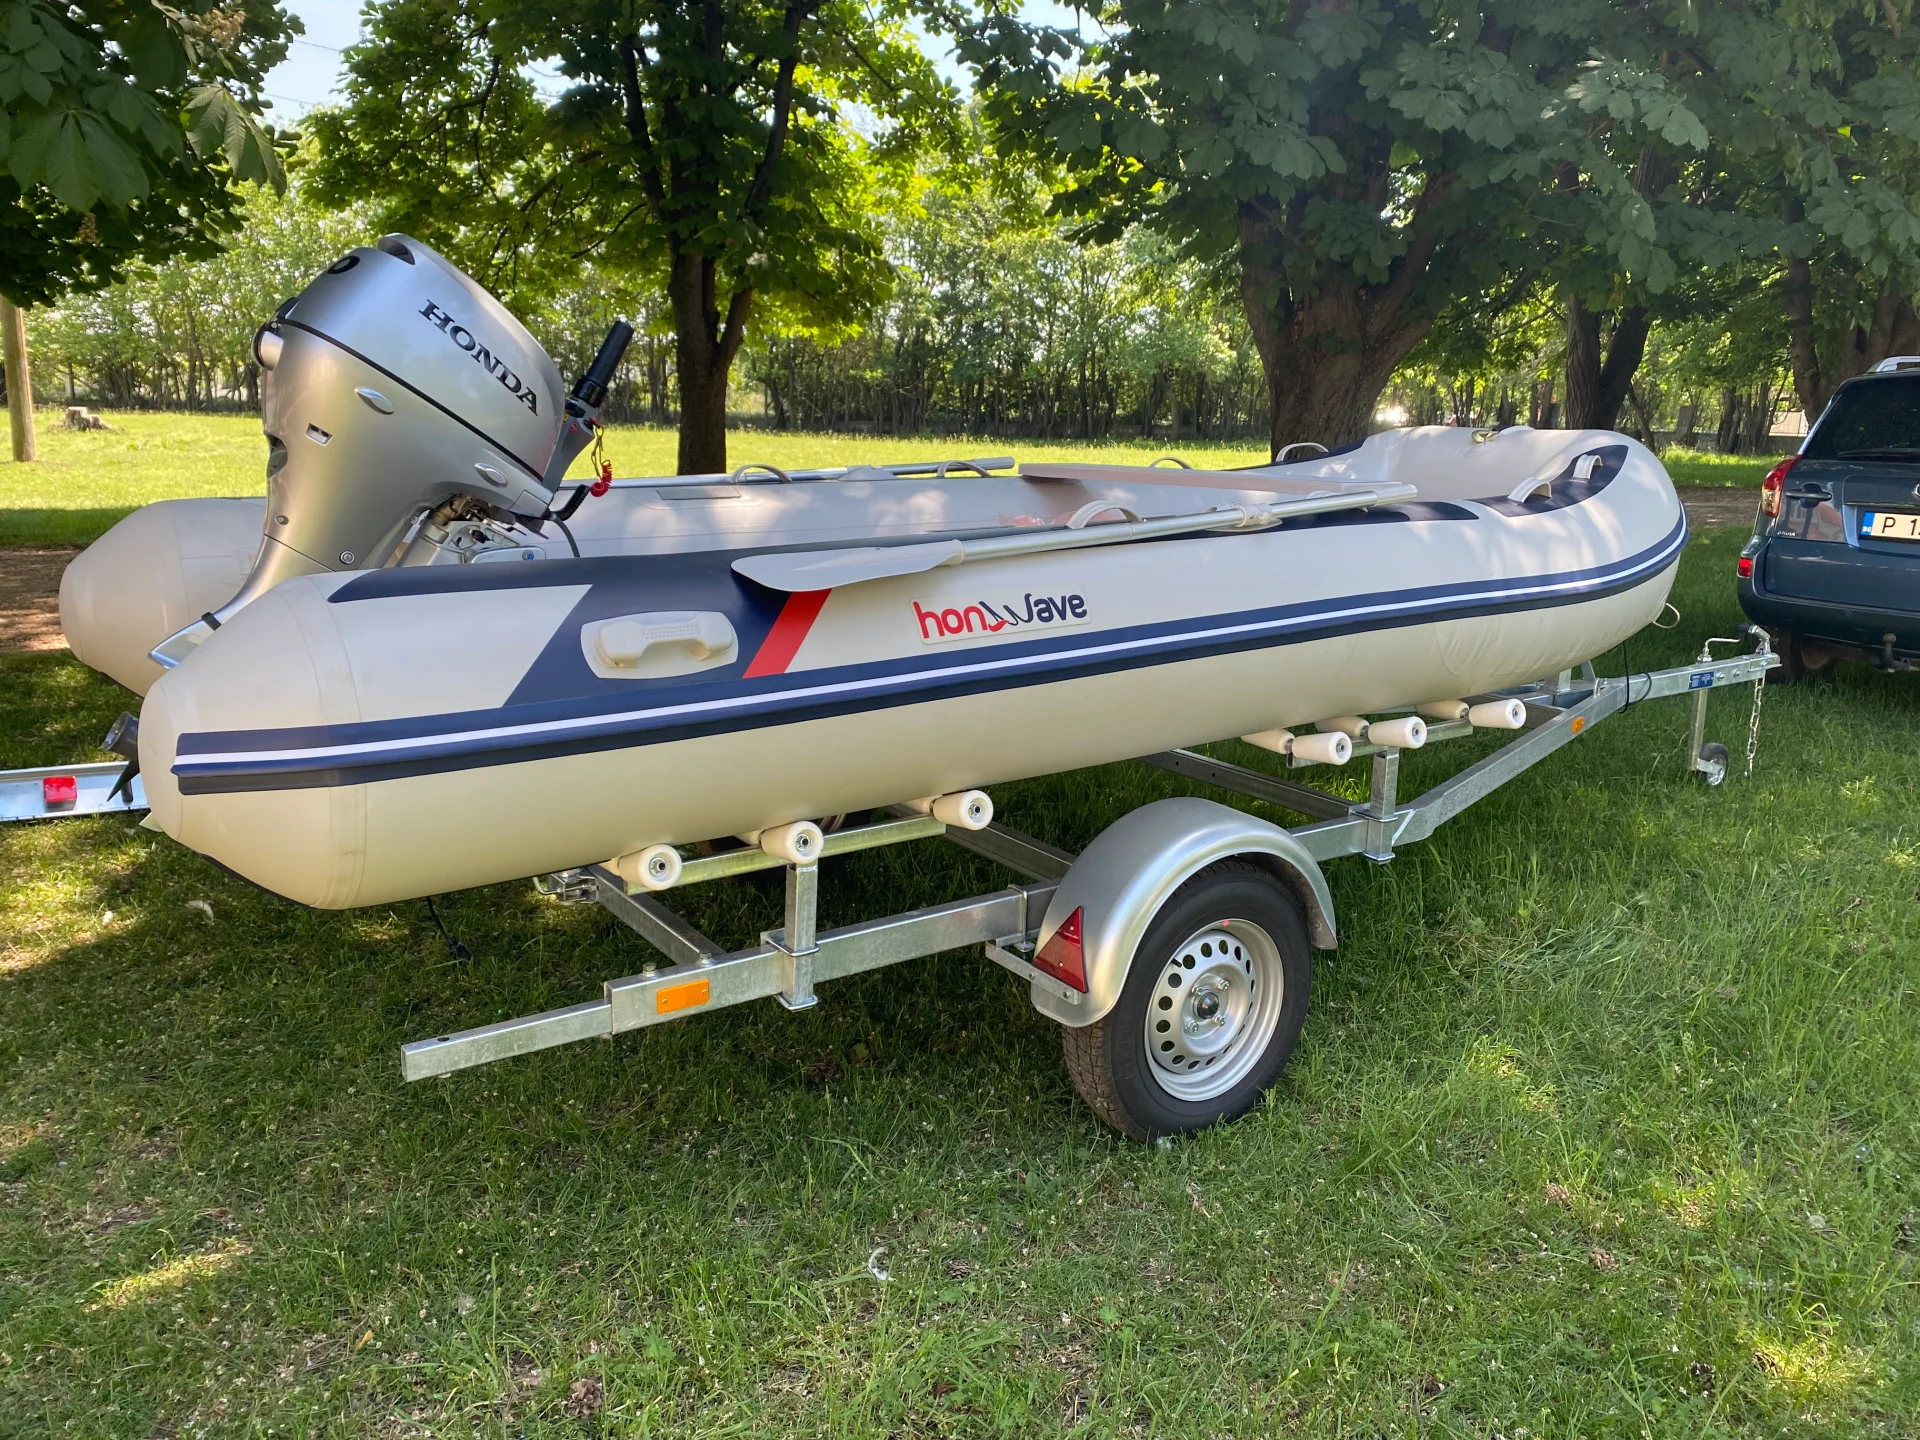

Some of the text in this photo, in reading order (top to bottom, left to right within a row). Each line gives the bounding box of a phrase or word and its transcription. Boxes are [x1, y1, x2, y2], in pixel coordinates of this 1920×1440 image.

[418, 299, 538, 416] HONDA
[1881, 516, 1920, 536] P 1
